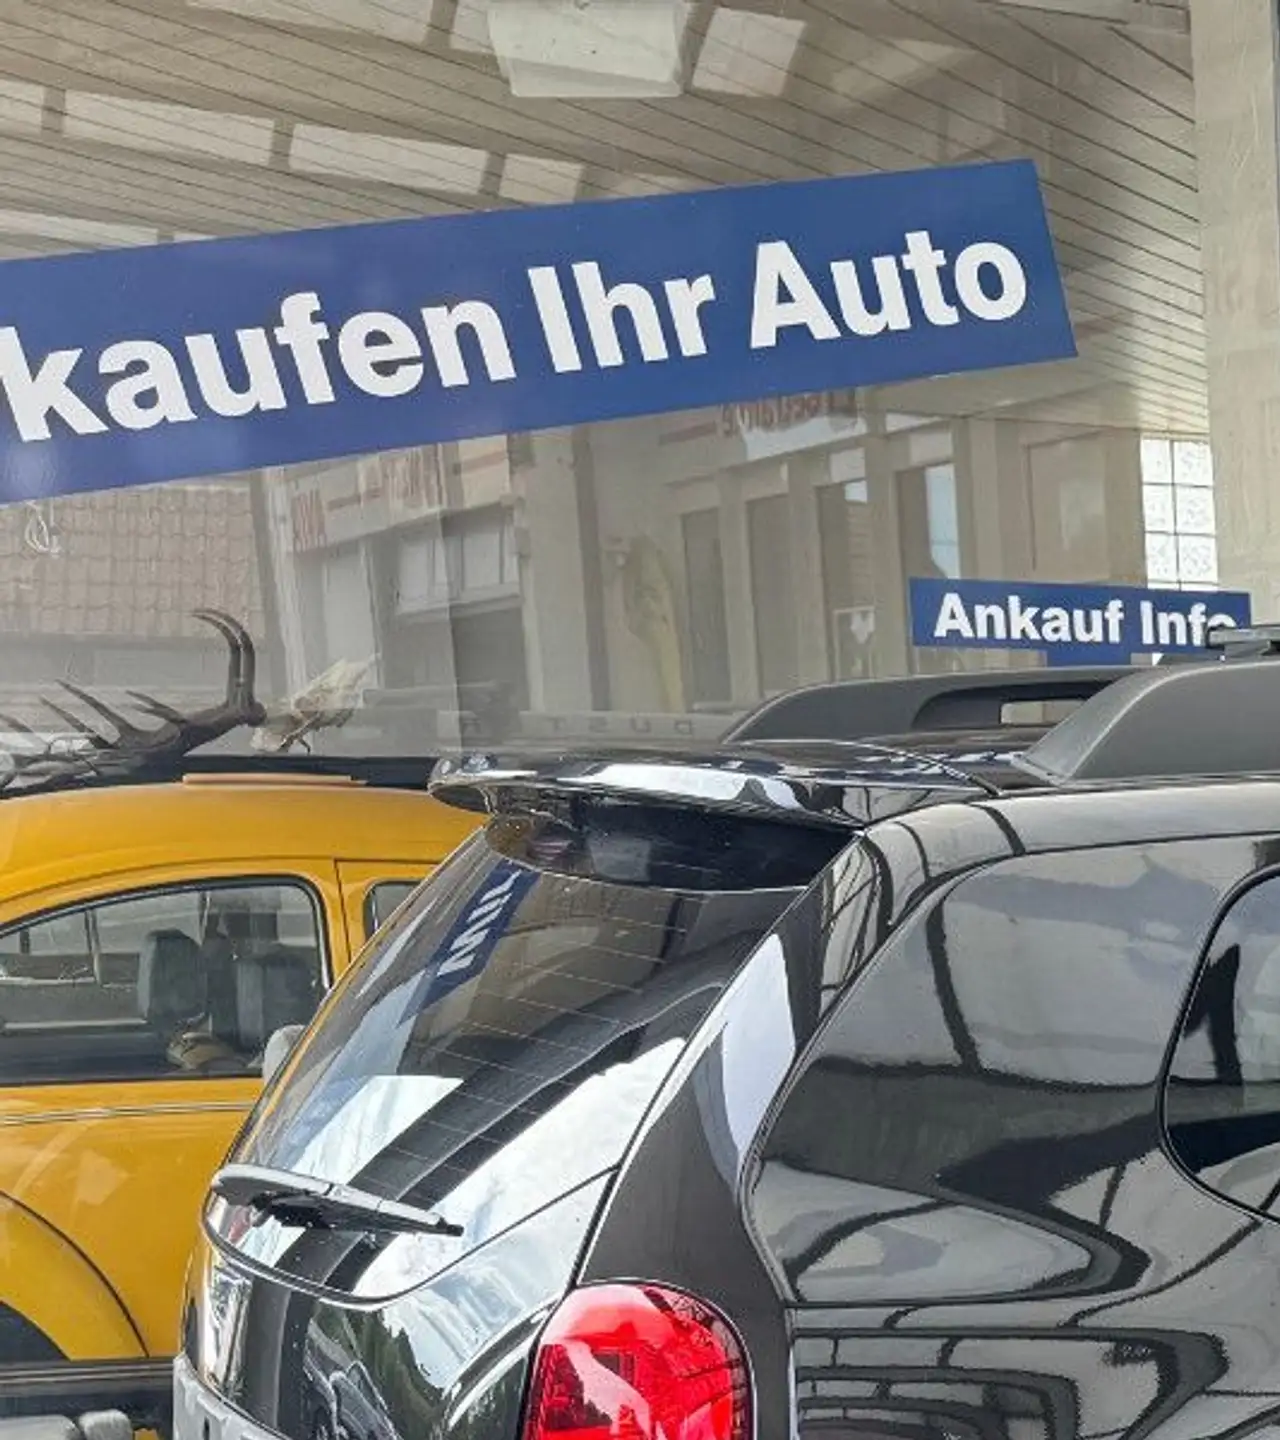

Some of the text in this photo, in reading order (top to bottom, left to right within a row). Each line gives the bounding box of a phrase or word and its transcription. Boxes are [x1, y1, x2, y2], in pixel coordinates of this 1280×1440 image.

[0, 230, 1027, 441] kaufen Ihr Auto
[933, 591, 1125, 643] Ankauf
